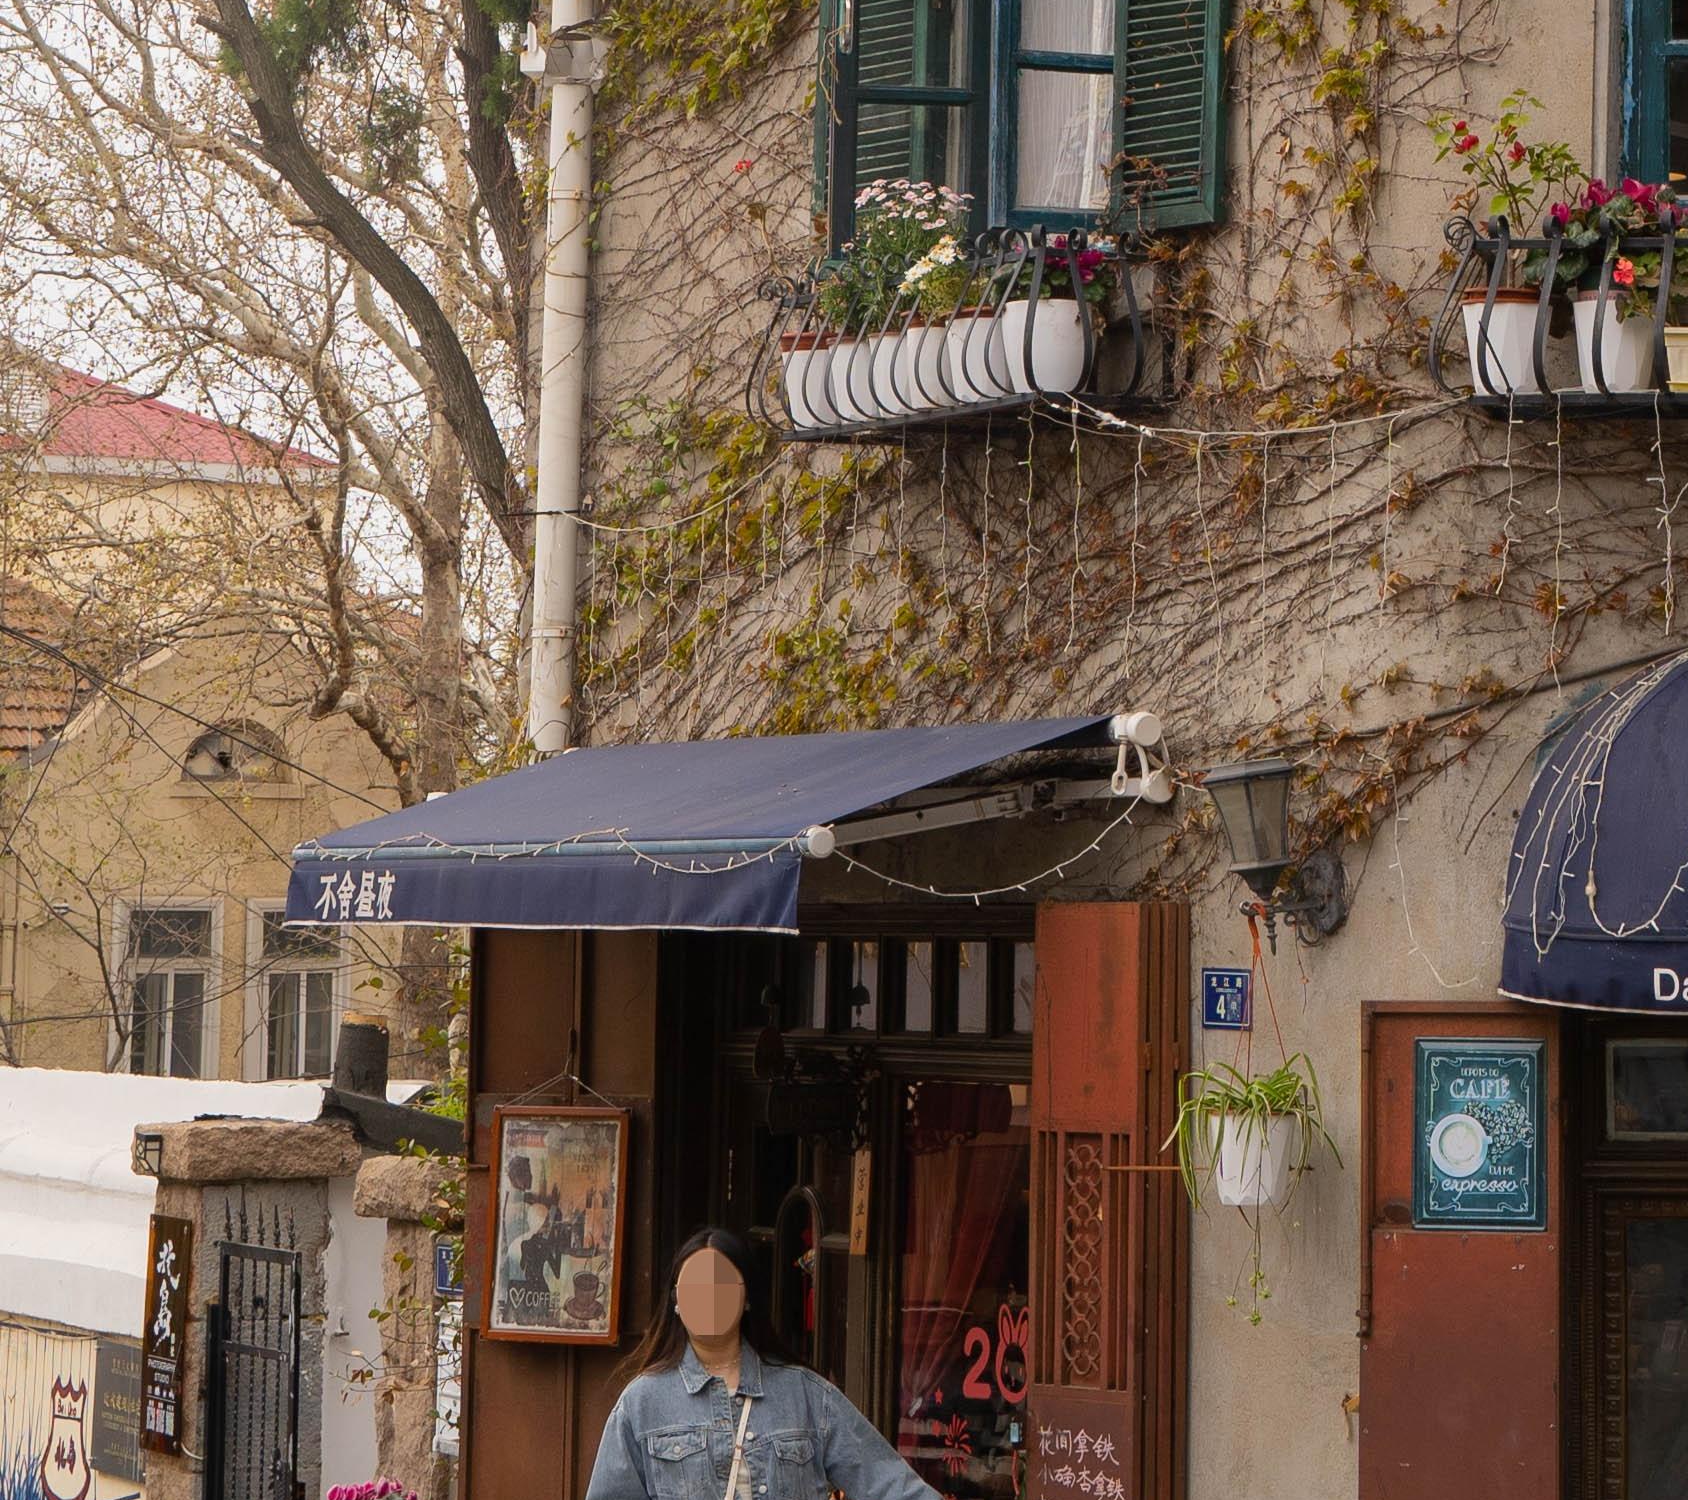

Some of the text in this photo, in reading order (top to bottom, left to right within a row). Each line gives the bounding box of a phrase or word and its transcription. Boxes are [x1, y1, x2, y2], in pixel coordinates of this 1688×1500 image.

[314, 870, 396, 920] 不舍昼夜
[1037, 1424, 1120, 1466] 花间拿铁
